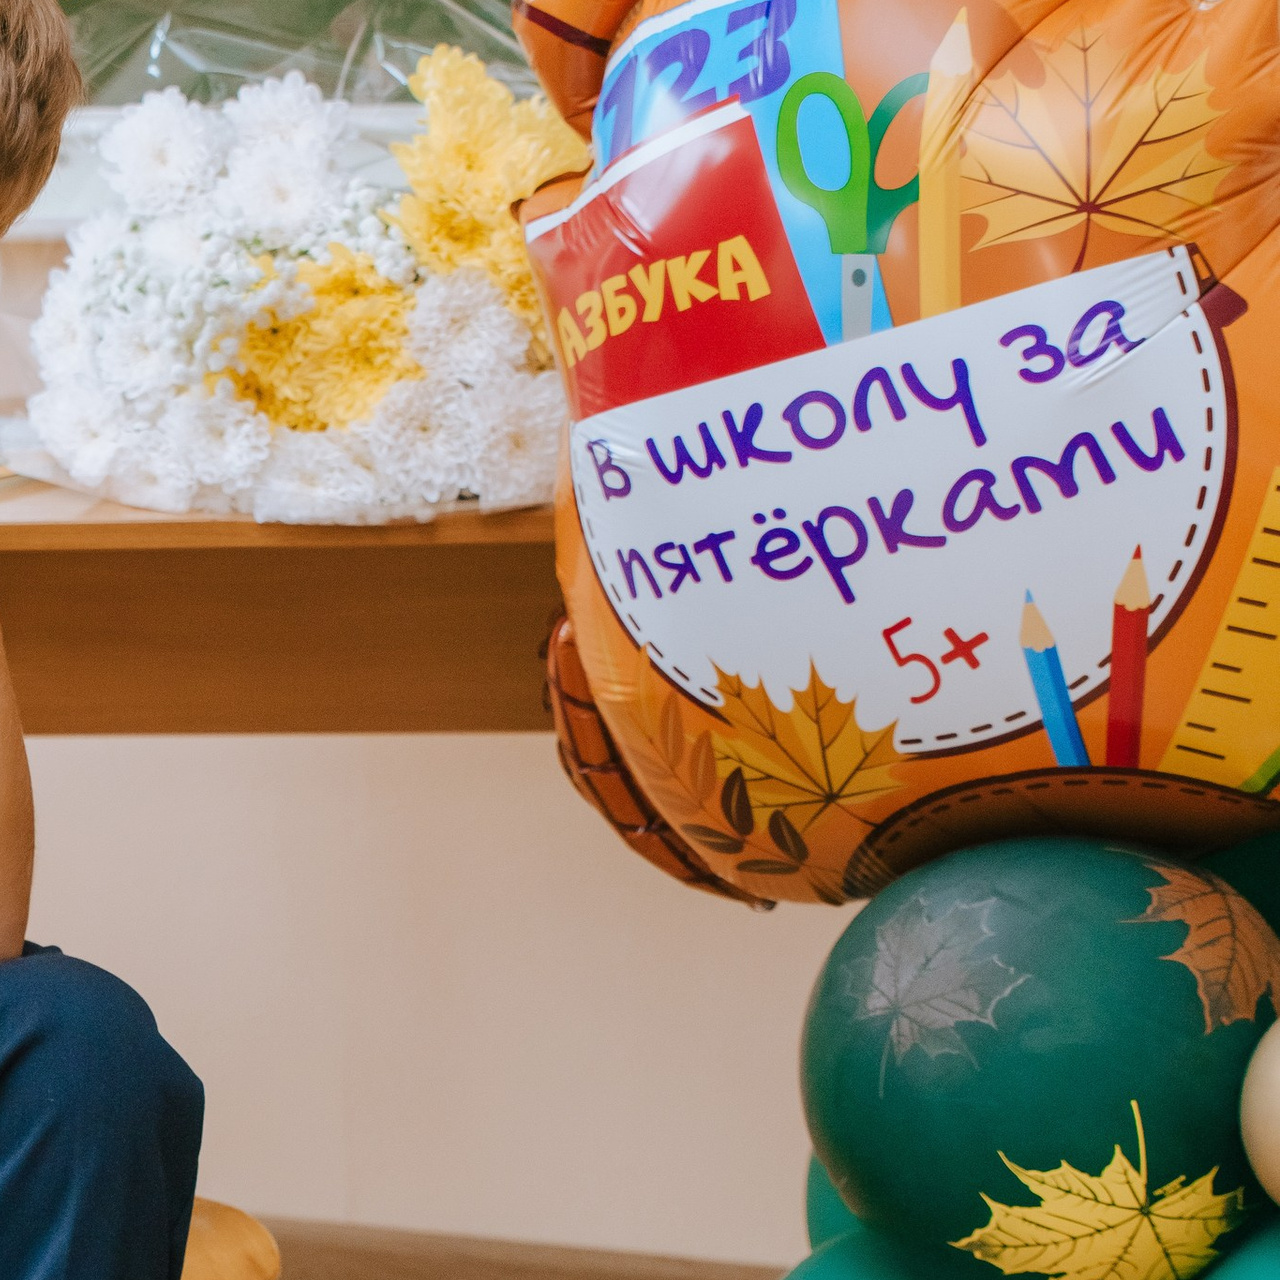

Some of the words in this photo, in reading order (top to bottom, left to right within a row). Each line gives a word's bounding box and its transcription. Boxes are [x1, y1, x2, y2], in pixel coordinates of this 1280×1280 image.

[556, 234, 771, 368] АЗБУКА
[645, 357, 988, 486] школу
[998, 299, 1147, 384] за
[616, 406, 1186, 605] пятёрками
[882, 616, 989, 705] 5+
